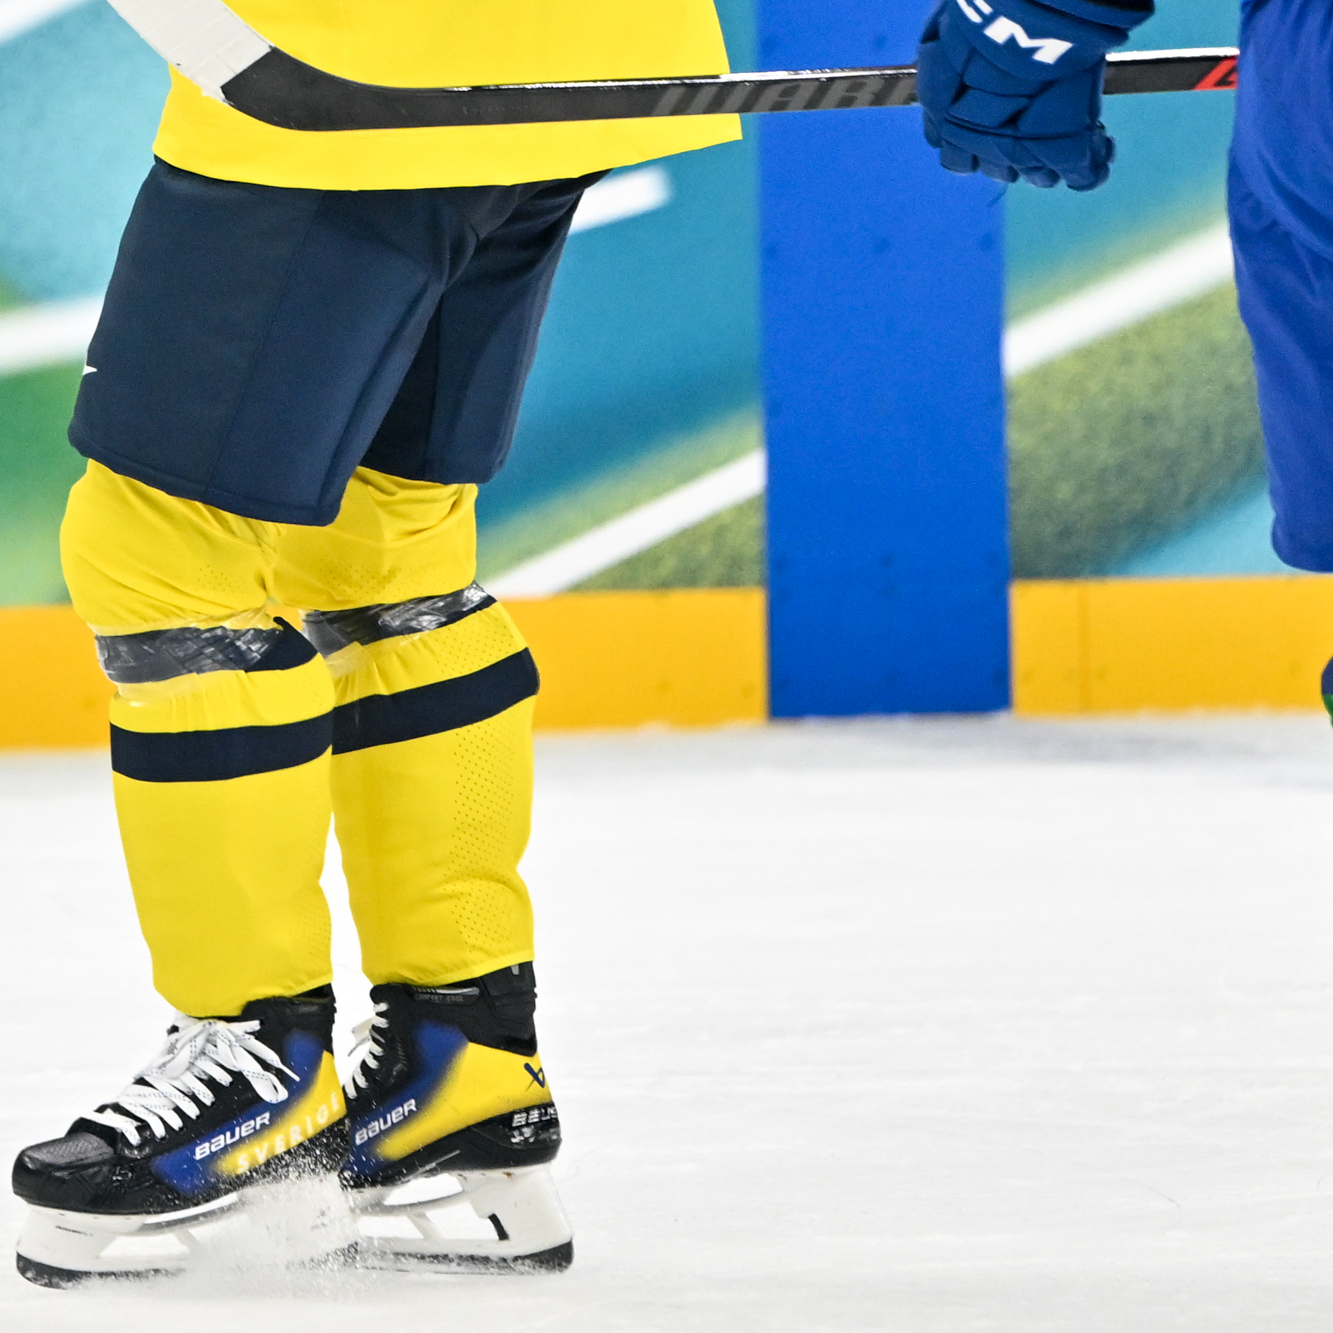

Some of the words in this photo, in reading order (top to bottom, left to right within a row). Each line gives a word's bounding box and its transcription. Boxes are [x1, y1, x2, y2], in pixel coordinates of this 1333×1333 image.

[193, 1111, 271, 1161] BAUER
[236, 1090, 340, 1175] SVERIGE
[354, 1098, 418, 1147] BAUER
